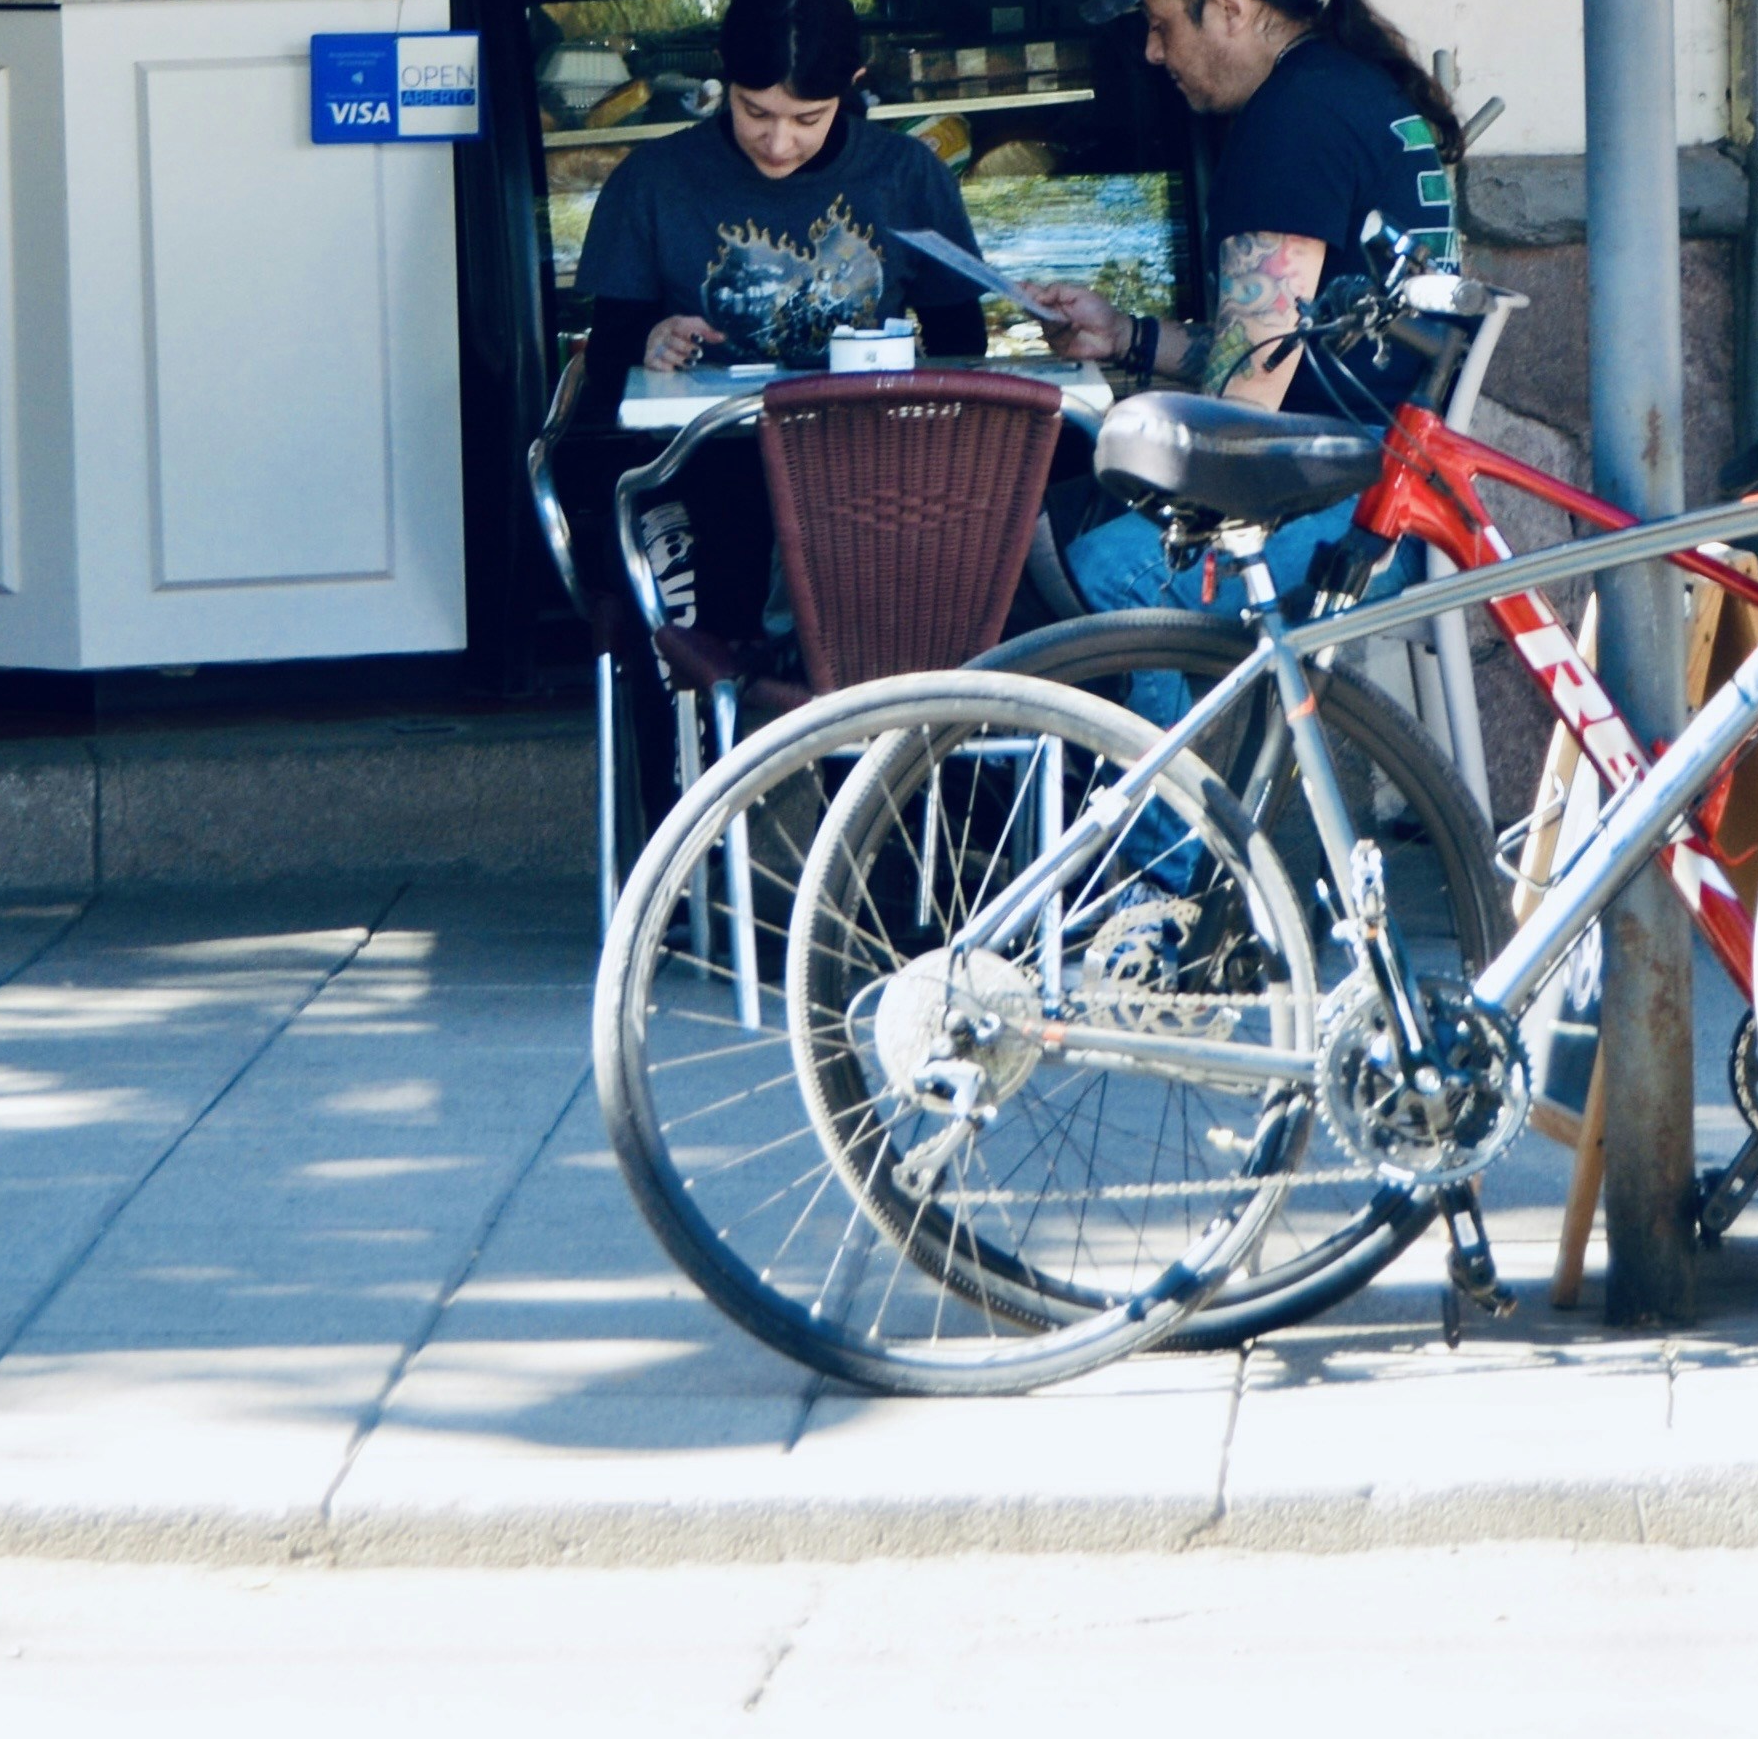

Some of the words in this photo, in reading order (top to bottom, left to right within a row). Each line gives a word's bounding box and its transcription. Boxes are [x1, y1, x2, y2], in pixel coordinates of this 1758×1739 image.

[402, 64, 475, 88] OPEN
[402, 90, 475, 106] ABIERTO
[326, 101, 391, 125] VISA
